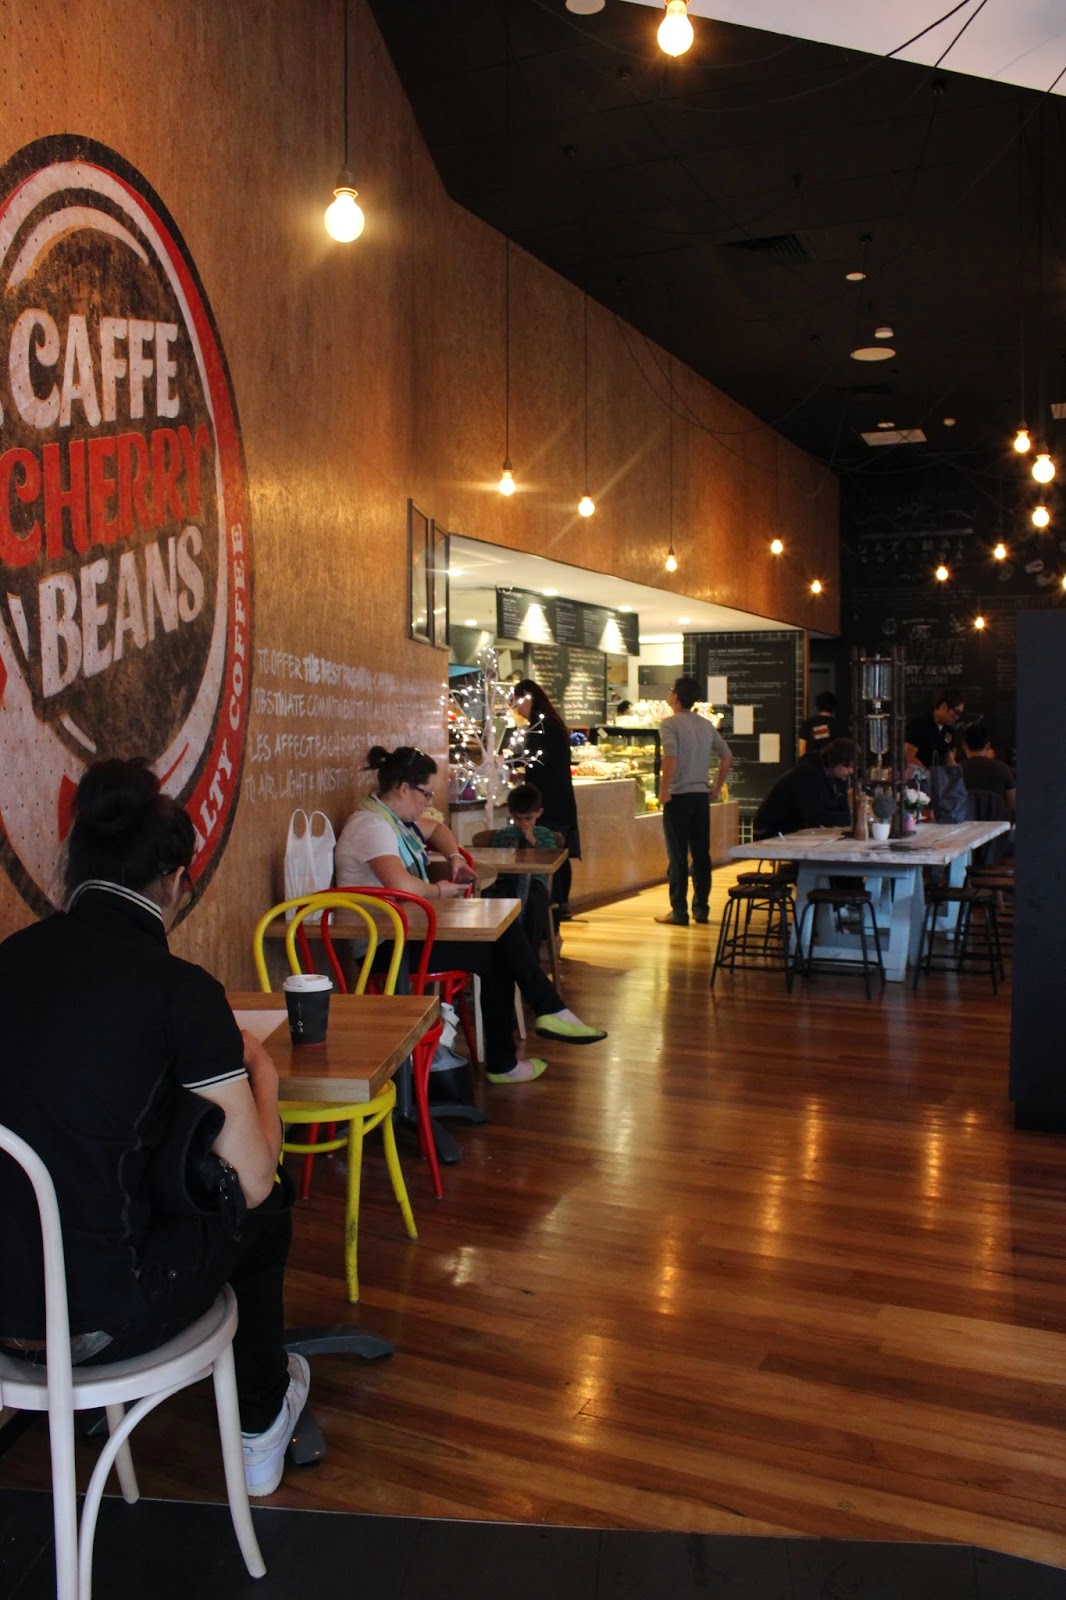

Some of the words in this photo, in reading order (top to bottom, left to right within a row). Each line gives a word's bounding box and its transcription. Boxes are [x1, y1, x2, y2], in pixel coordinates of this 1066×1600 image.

[9, 307, 180, 430] CAFFE
[0, 423, 210, 568] CHERRY
[38, 525, 205, 698] BEANS
[229, 523, 246, 731] COFFEE
[271, 649, 304, 681] OFFER
[274, 732, 315, 759] AFFECT
